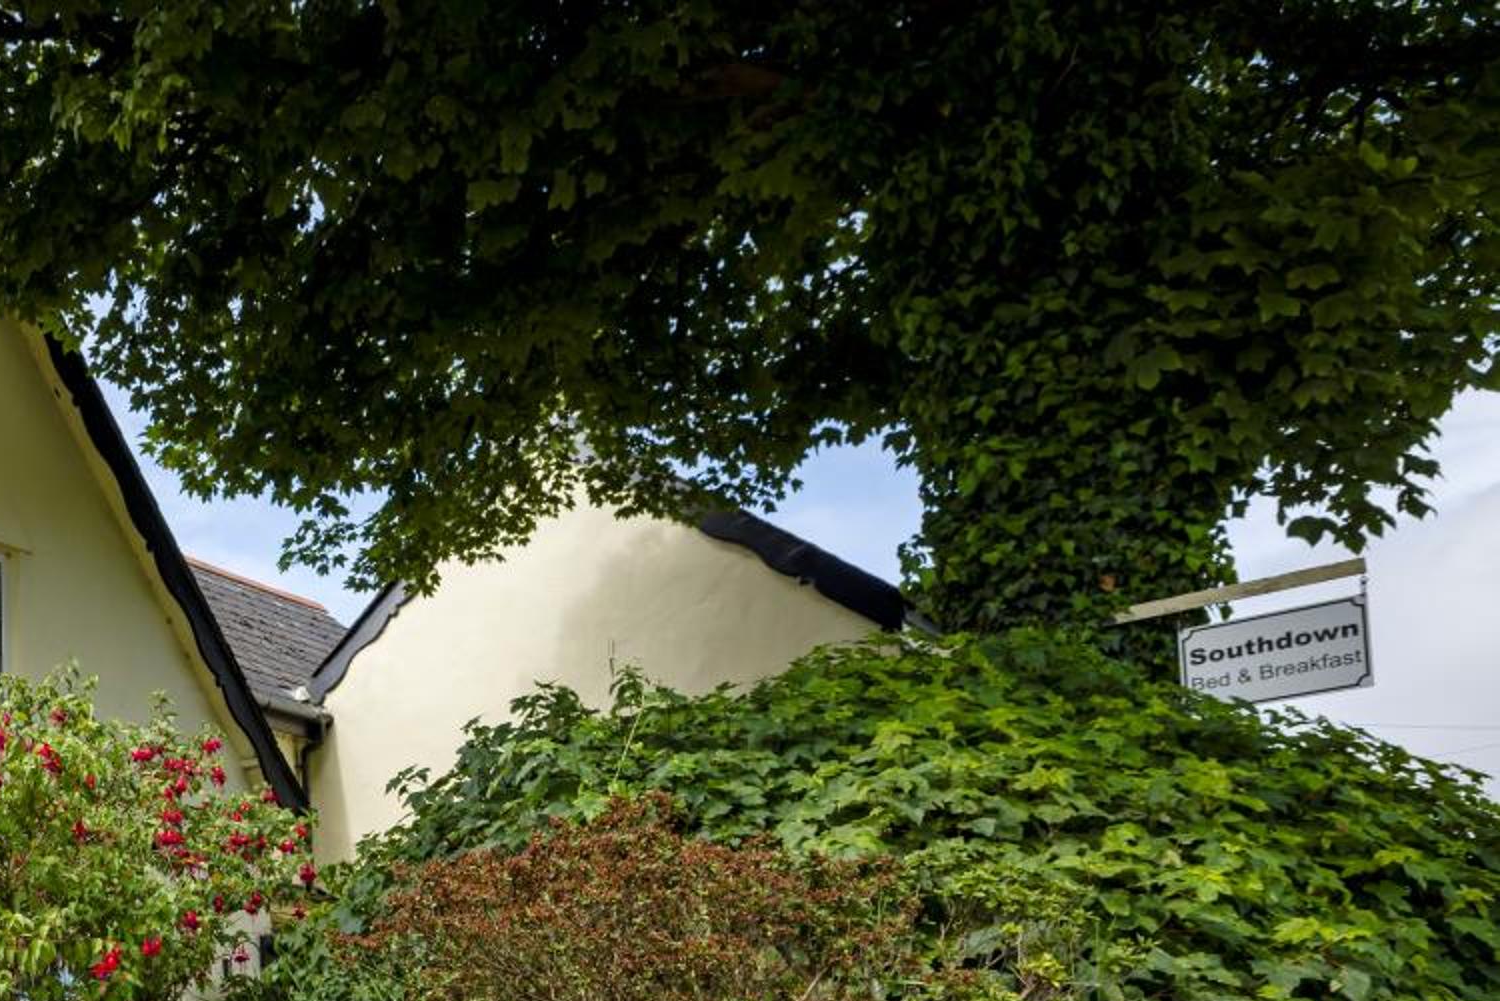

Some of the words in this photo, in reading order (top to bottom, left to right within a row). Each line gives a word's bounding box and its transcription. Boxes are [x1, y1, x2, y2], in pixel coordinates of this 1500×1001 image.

[1190, 622, 1359, 666] Southdown
[1191, 671, 1230, 691] Bed
[1237, 668, 1251, 683] &
[1260, 650, 1362, 681] Breakfast
